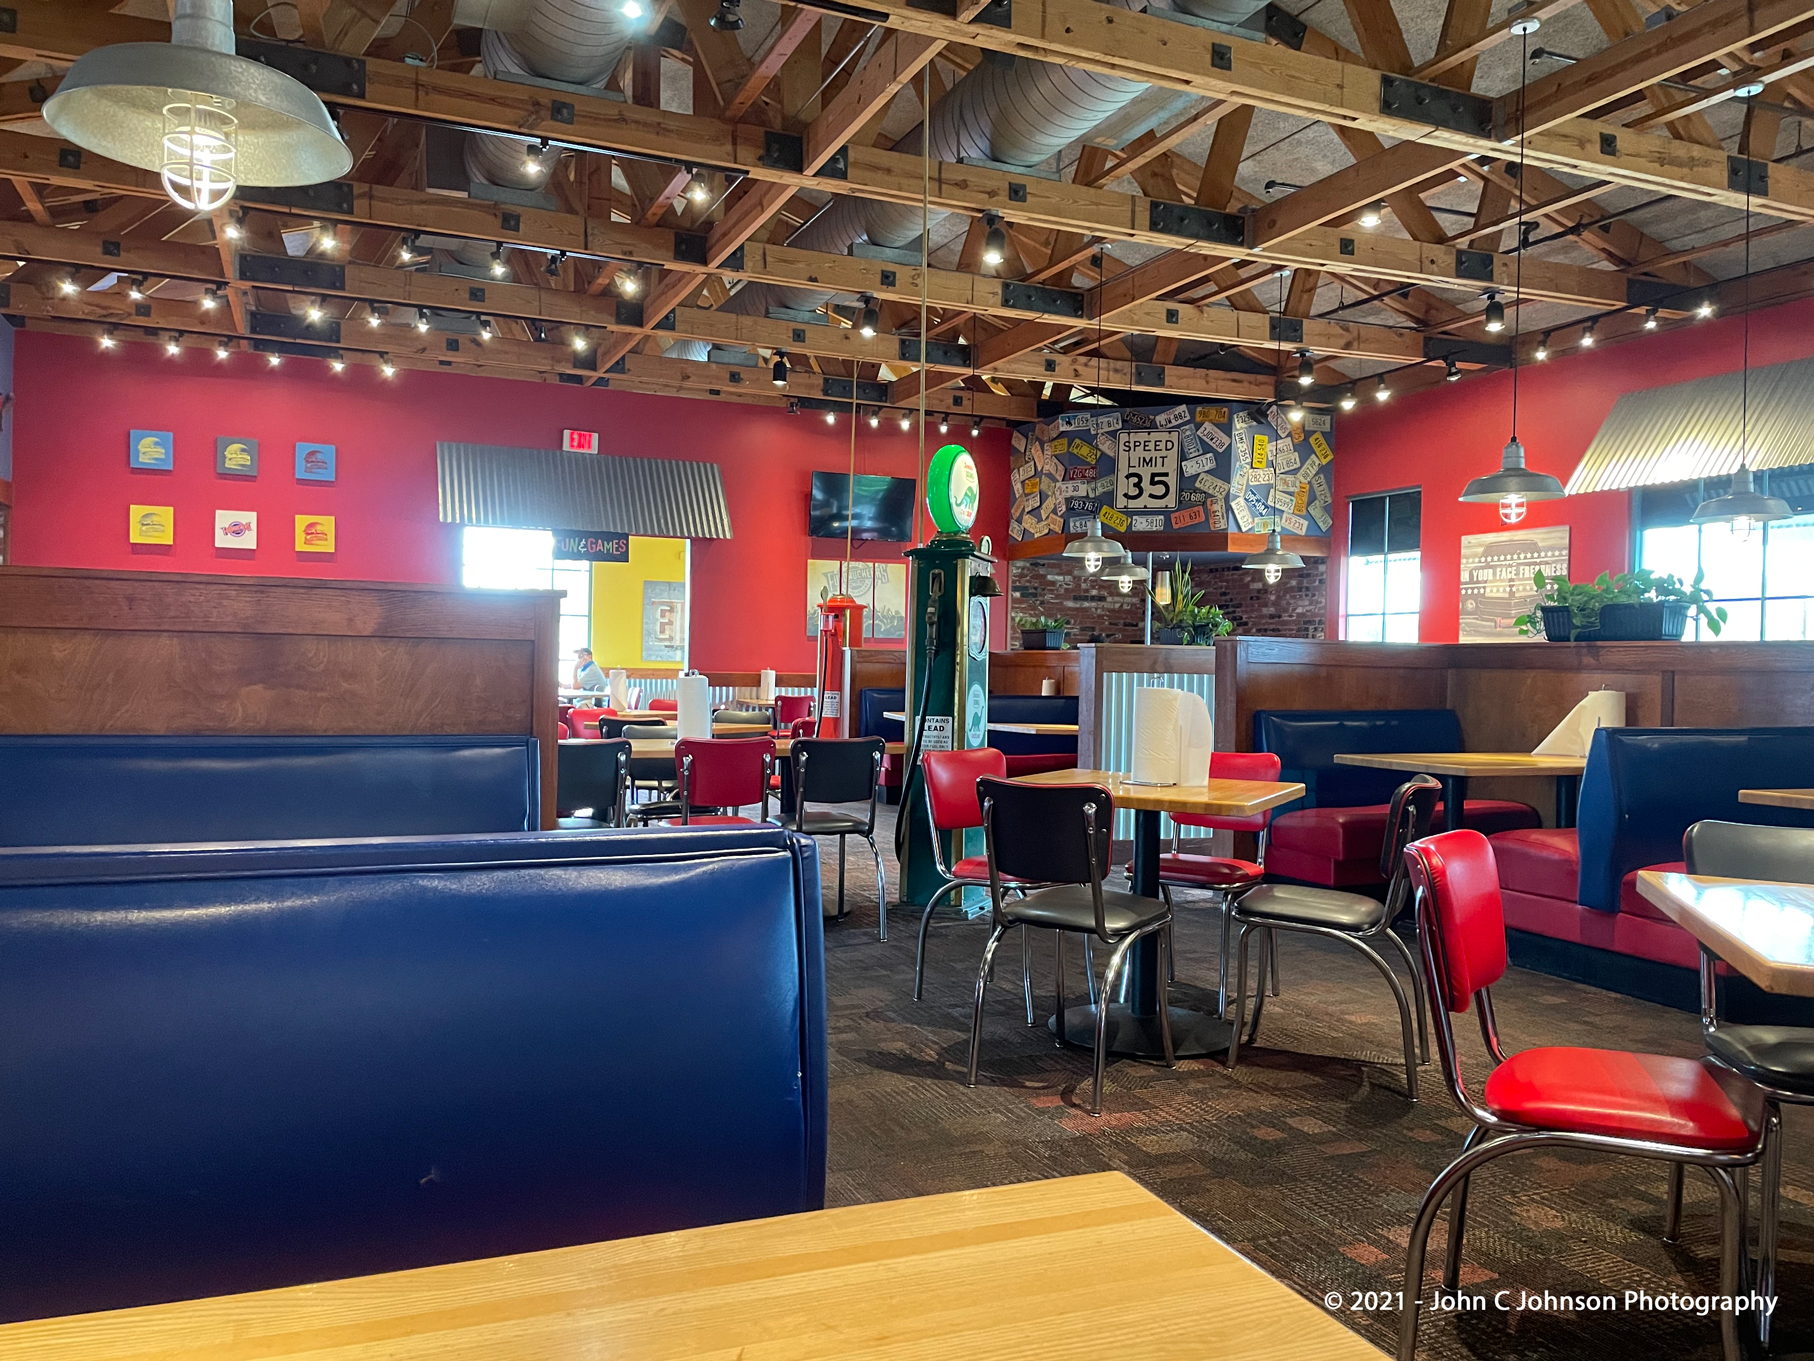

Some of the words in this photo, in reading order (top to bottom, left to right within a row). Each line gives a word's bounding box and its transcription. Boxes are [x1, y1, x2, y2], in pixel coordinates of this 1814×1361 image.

[569, 431, 593, 451] EXIT
[1122, 440, 1175, 452] SPEED
[1128, 456, 1168, 468] LIMIT
[1122, 472, 1170, 500] 35
[1473, 568, 1493, 581] YOUR
[1497, 566, 1516, 579] FACE
